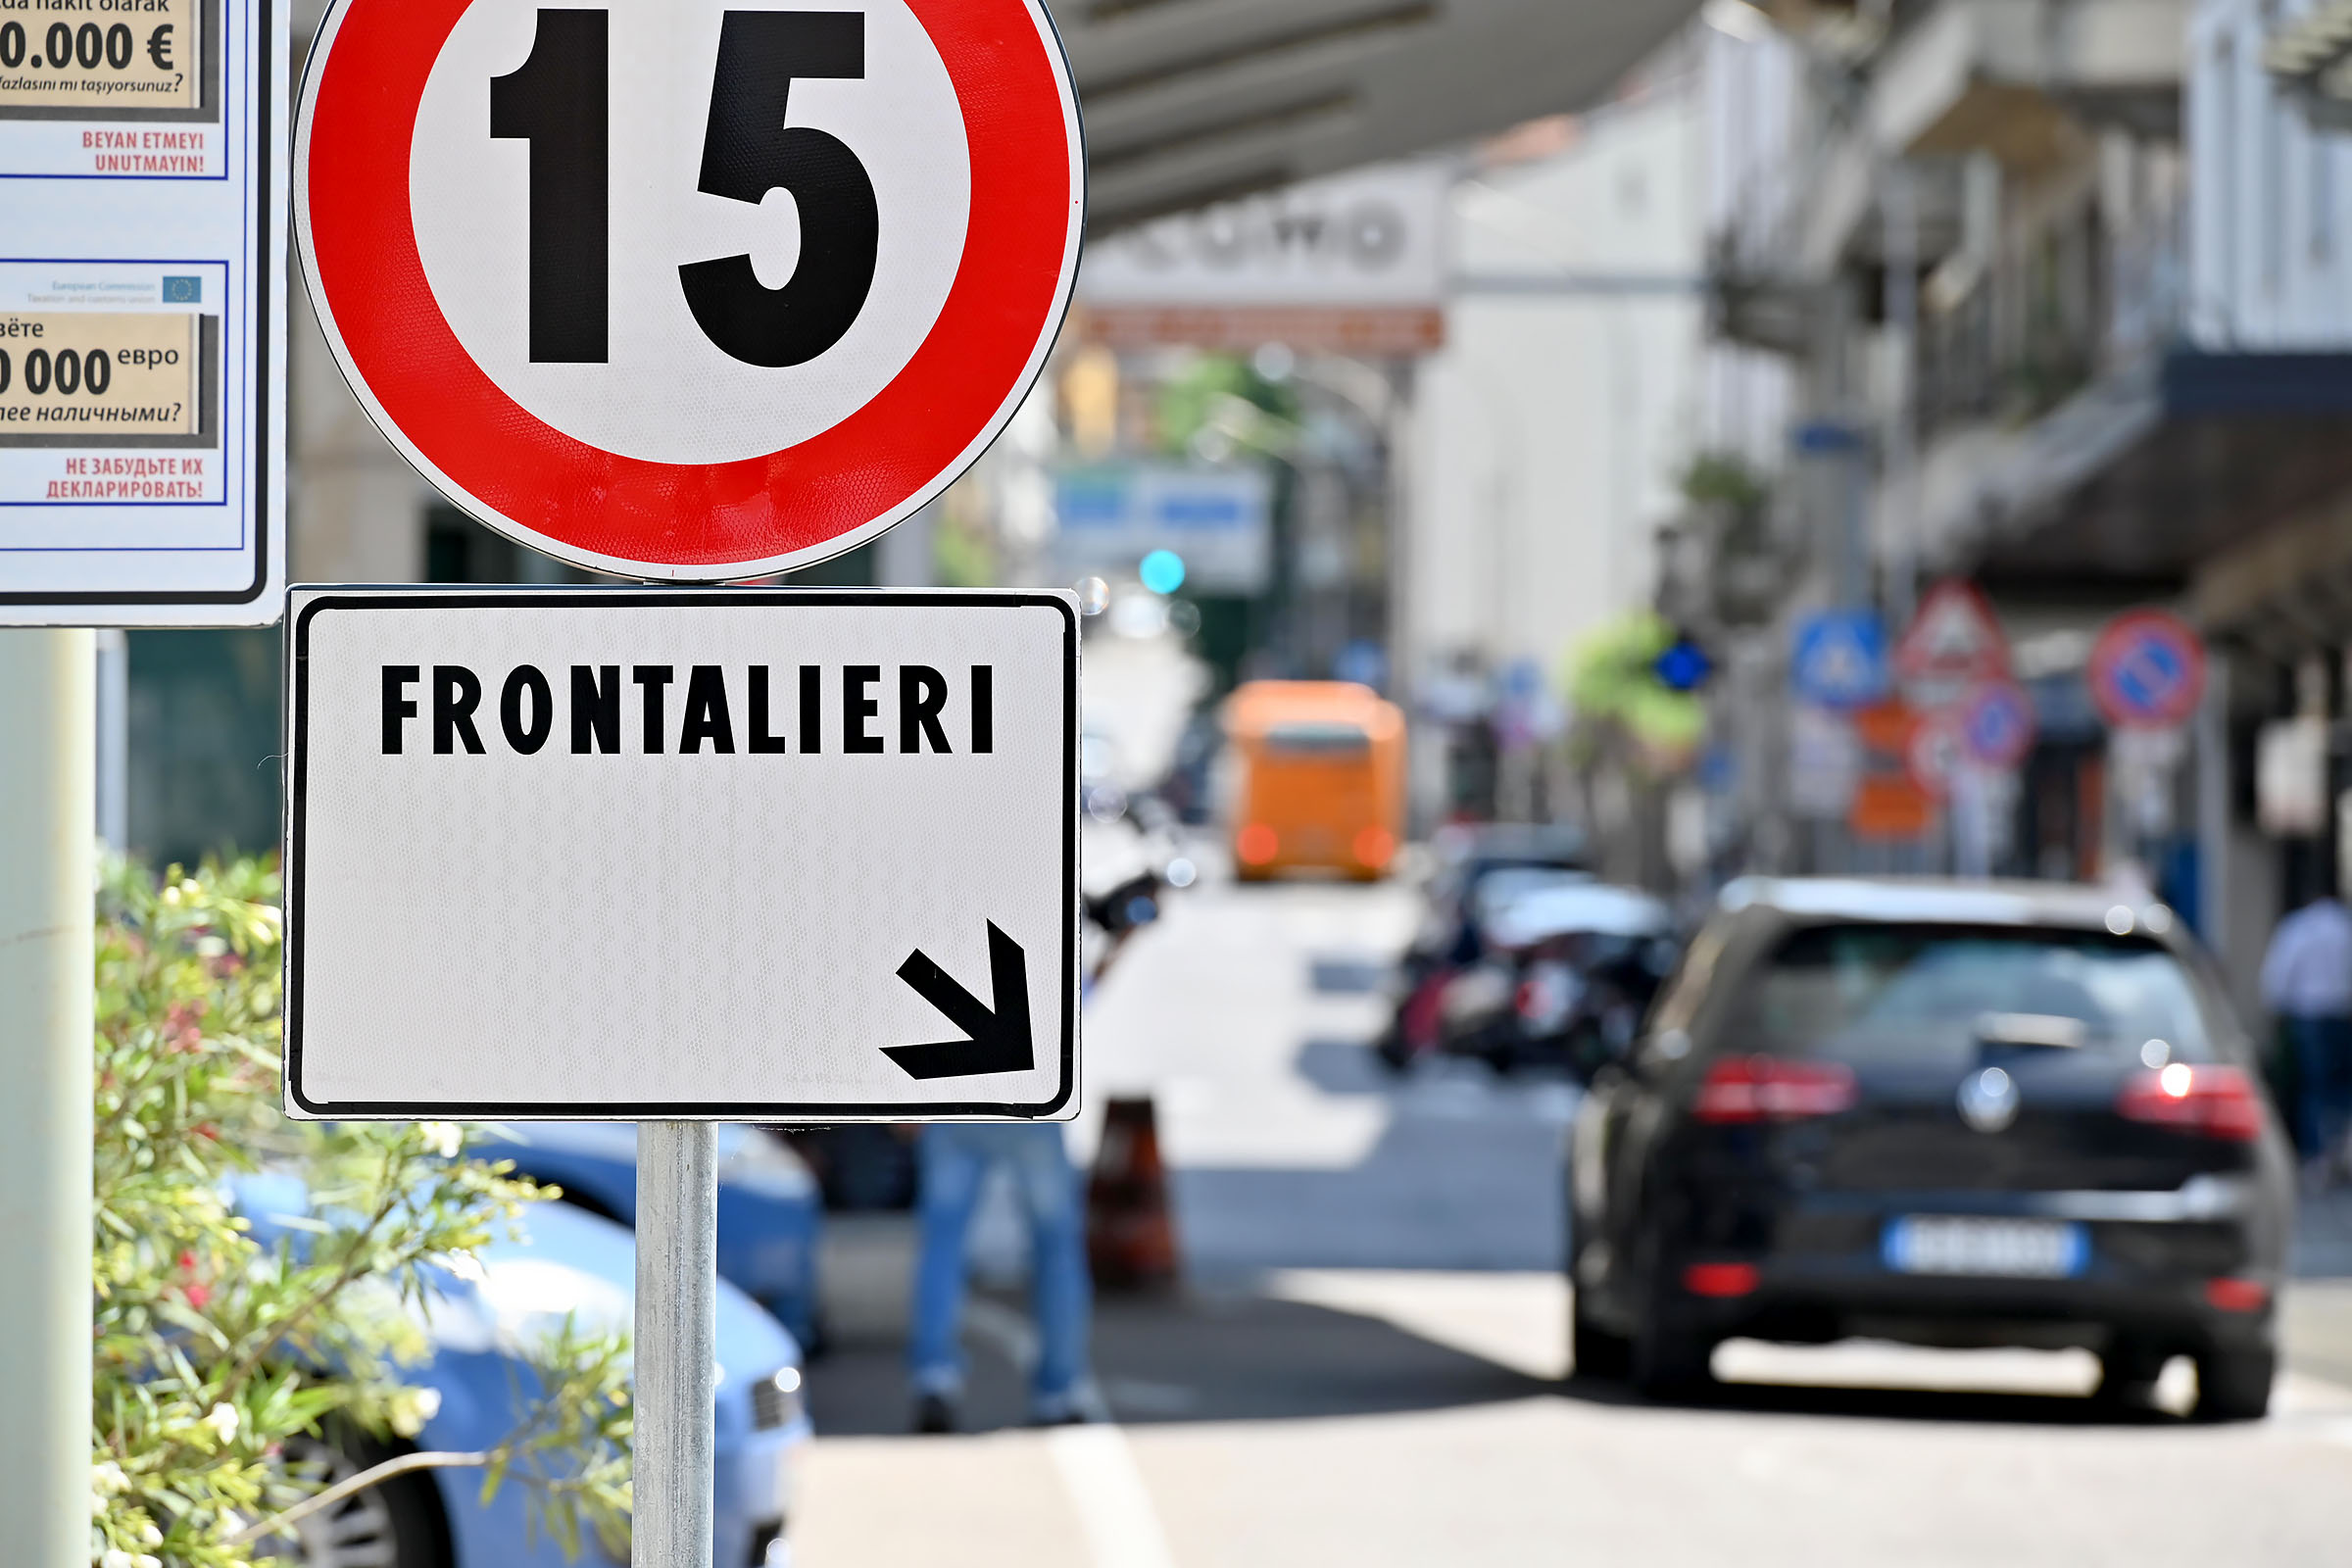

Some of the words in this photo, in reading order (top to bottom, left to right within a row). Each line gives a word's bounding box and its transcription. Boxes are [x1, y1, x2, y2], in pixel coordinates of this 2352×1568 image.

[147, 24, 173, 71] €
[82, 130, 137, 149] BEYAN
[95, 154, 204, 172] UNUTMAYIN!
[490, 8, 879, 368] 15
[118, 349, 179, 370] евро
[36, 403, 182, 422] наличными?
[66, 457, 87, 475] НЕ
[91, 458, 176, 478] ЗАБУДЬТЕ
[182, 459, 204, 475] ИХ
[46, 480, 203, 500] ДЕКЛАРИРОВАТЬ!
[380, 663, 993, 756] FRONTALIERI
